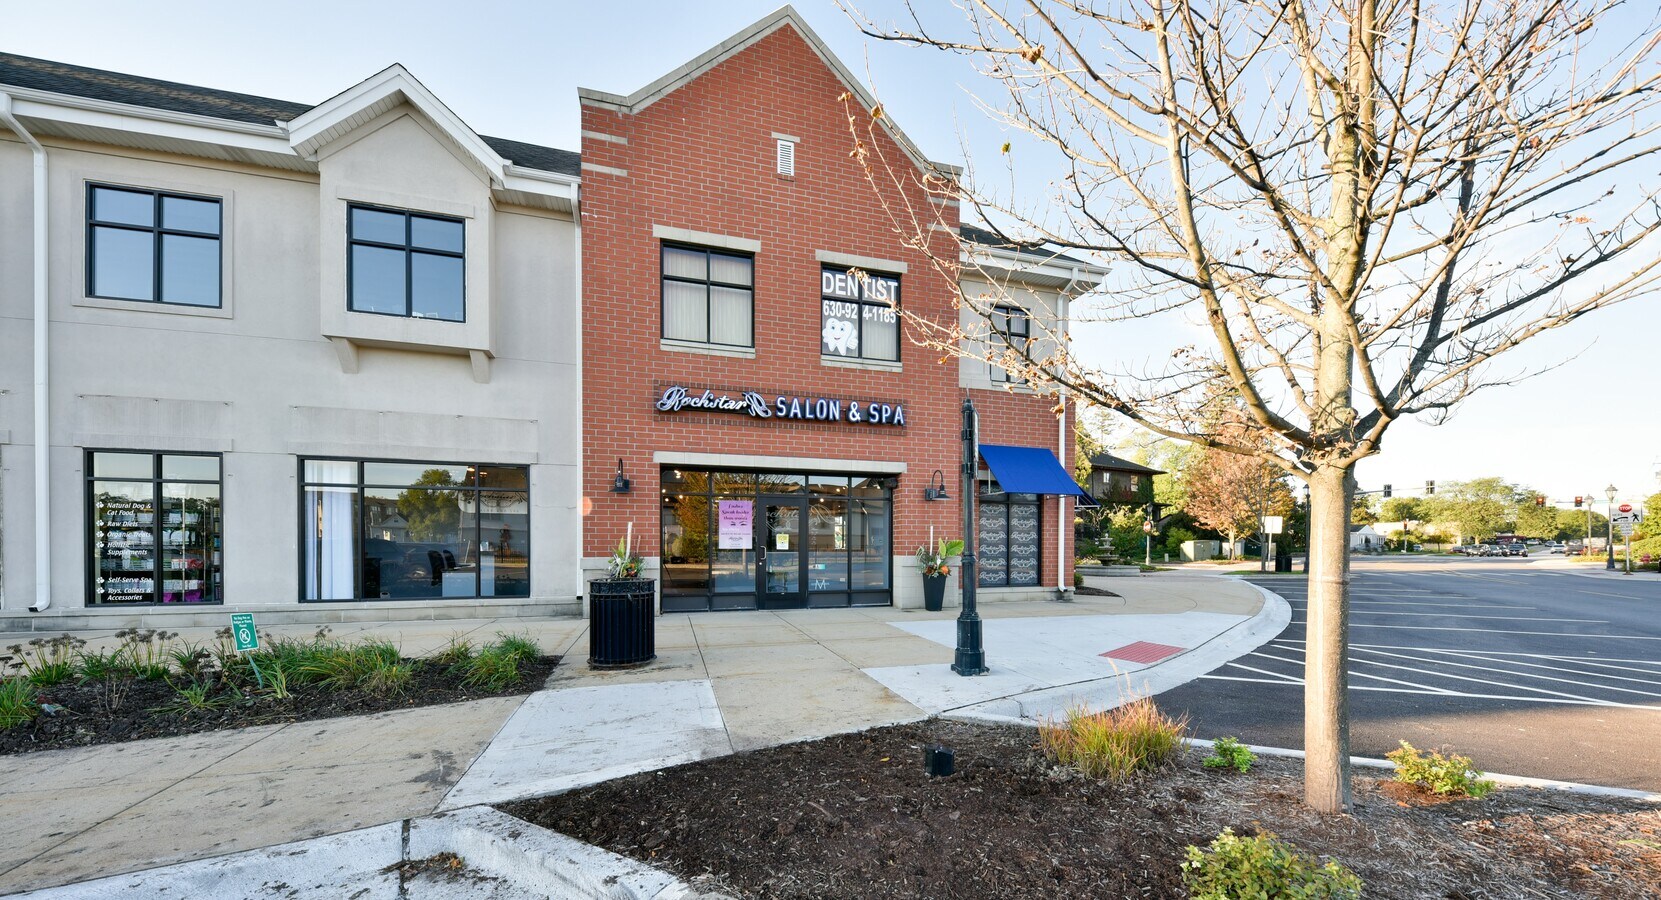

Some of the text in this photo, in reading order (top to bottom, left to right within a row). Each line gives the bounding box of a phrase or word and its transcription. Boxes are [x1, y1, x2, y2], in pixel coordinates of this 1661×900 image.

[823, 272, 898, 302] DENTIST
[656, 385, 904, 424] Rockstar SALON & SPA
[107, 531, 131, 539] Organic
